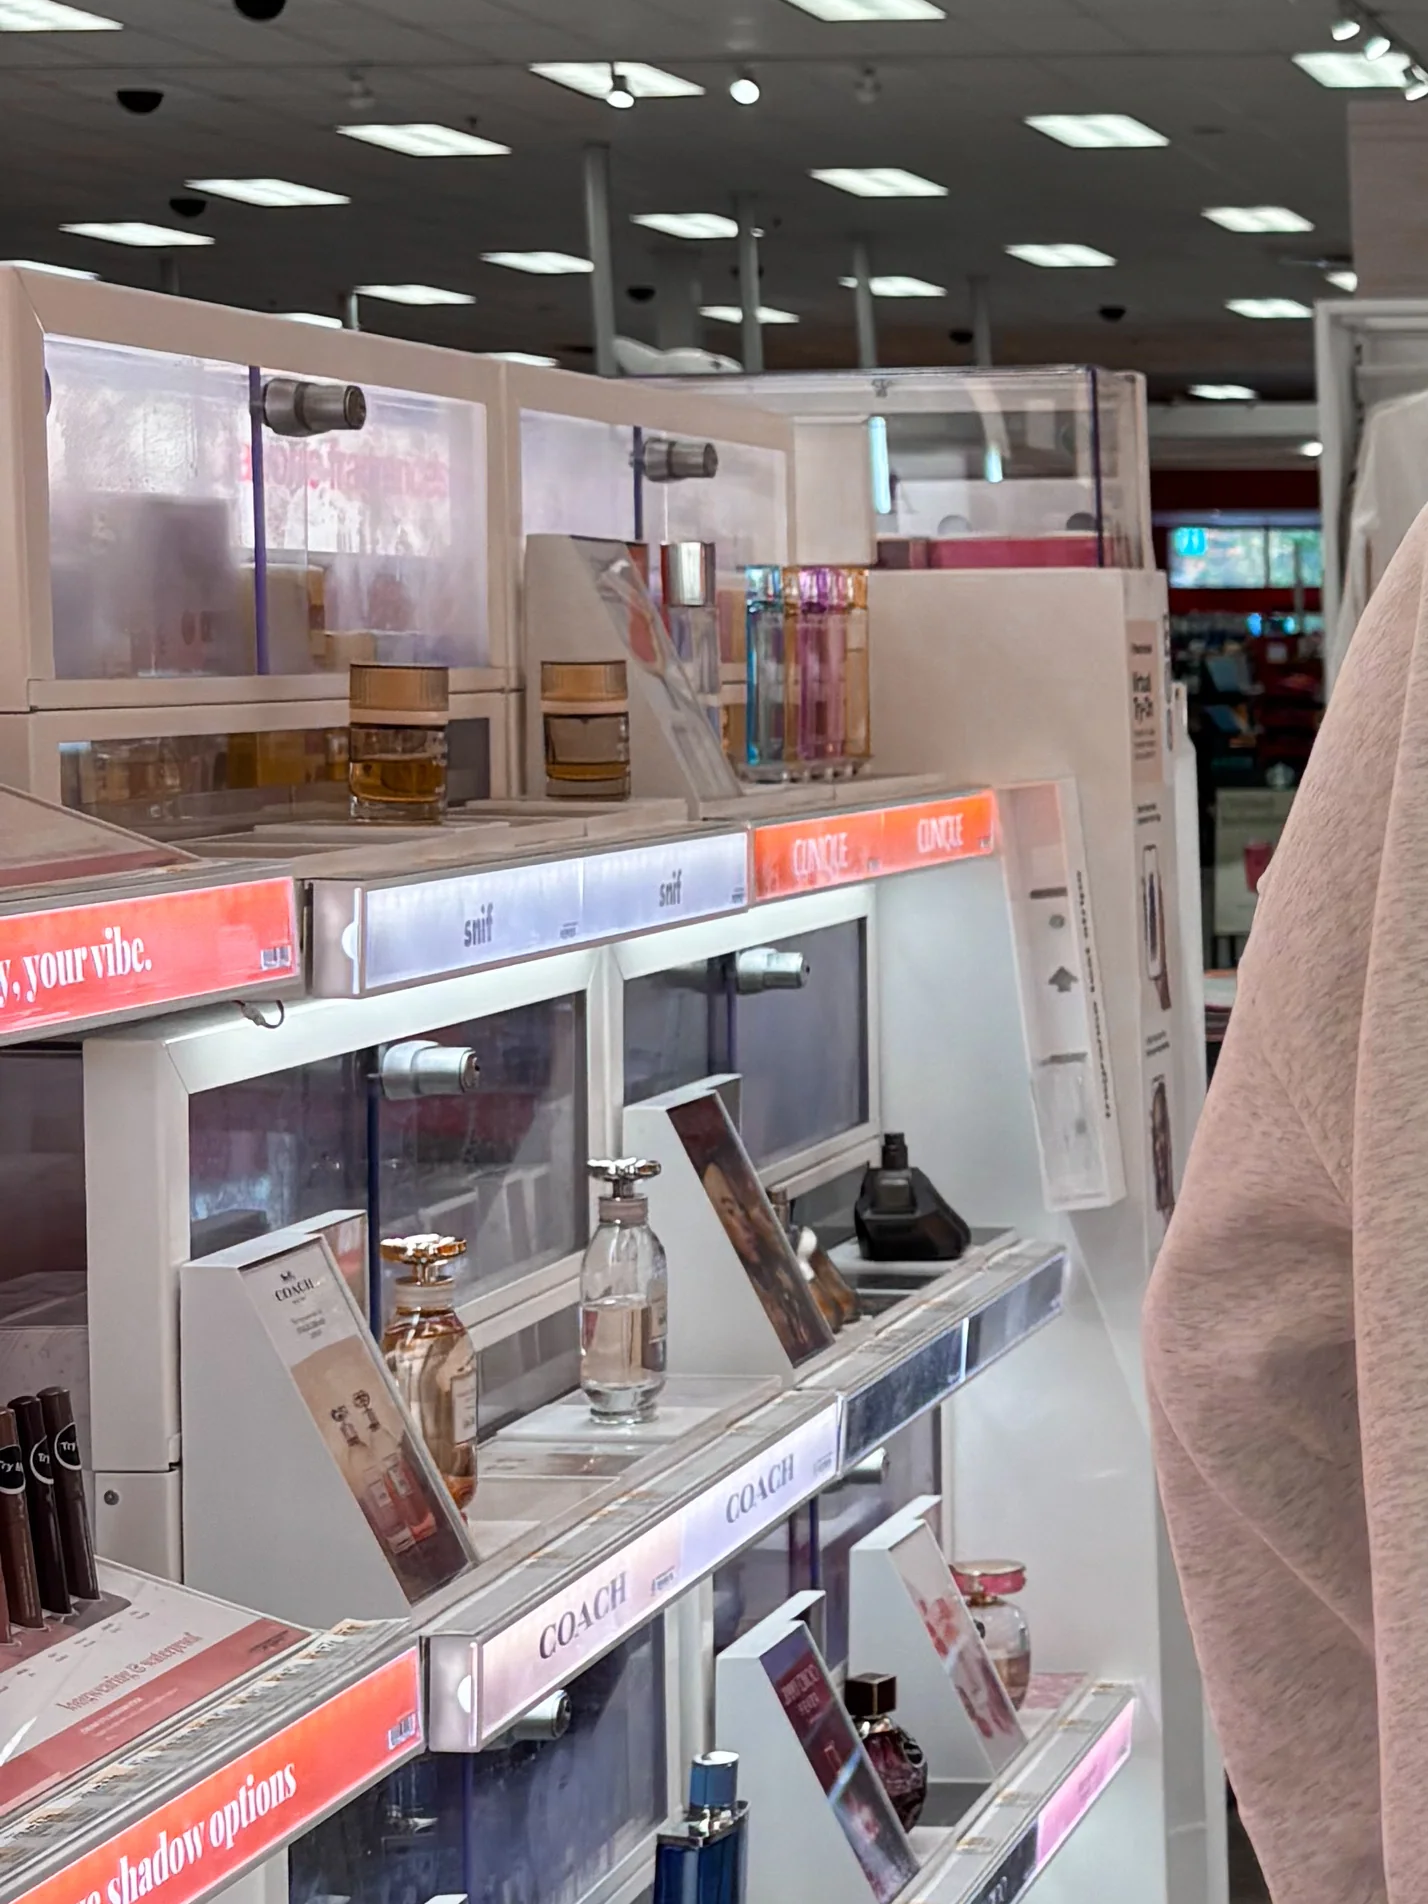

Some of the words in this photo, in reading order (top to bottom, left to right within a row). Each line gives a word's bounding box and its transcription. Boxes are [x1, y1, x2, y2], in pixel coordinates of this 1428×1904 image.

[793, 831, 850, 879] CLINIQUE
[918, 813, 965, 854] CLINIQUE
[659, 868, 683, 907] snif
[463, 902, 494, 948] snif
[23, 945, 87, 1002] your
[91, 926, 152, 979] vibe.
[275, 1278, 315, 1302] COACH
[726, 1452, 795, 1524] COACH
[538, 1570, 627, 1660] COACH
[209, 1763, 297, 1849] options
